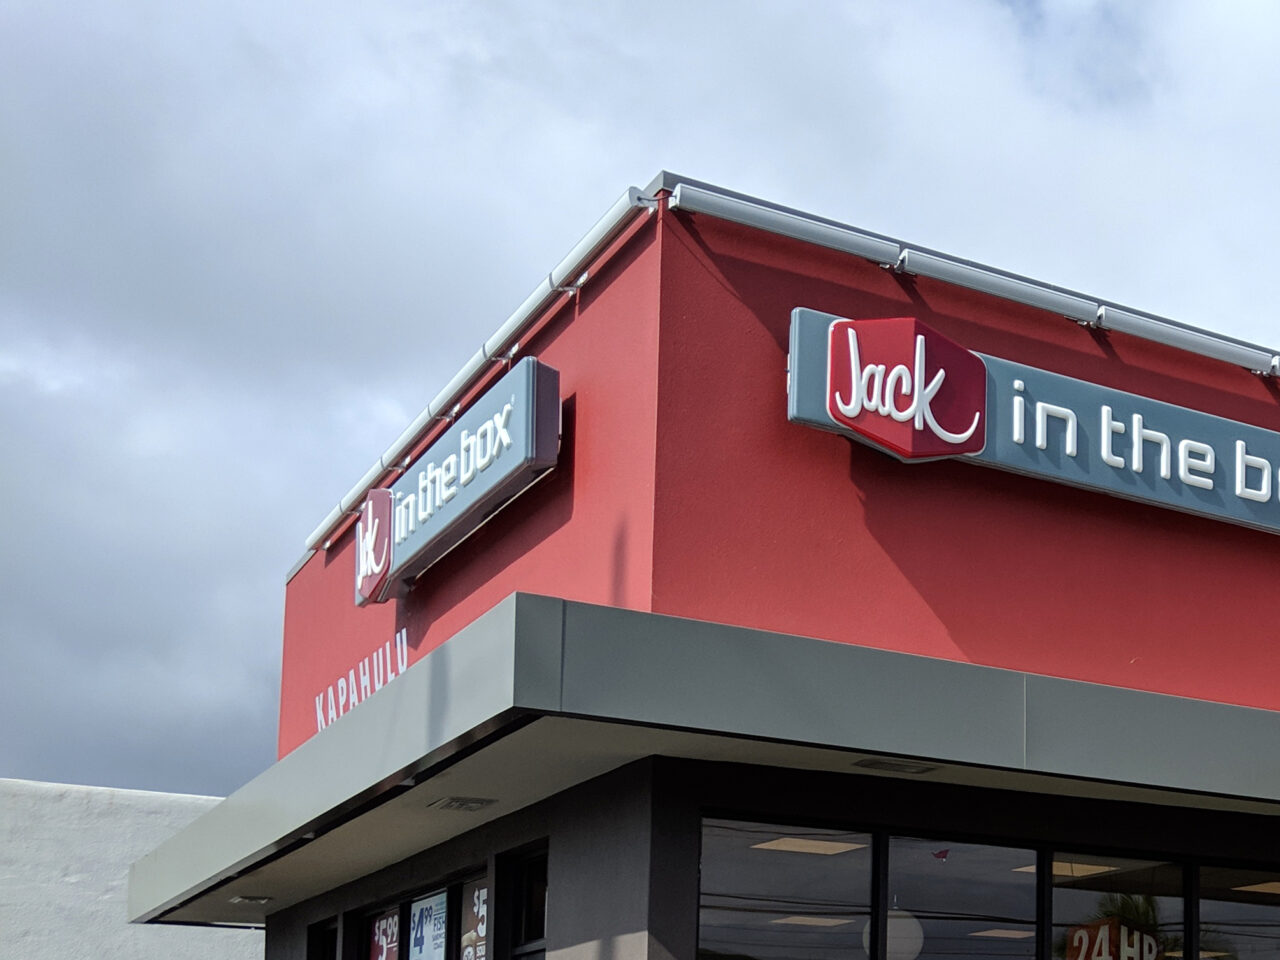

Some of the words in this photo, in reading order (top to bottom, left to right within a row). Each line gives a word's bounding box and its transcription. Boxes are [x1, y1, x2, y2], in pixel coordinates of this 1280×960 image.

[395, 491, 416, 545] in
[418, 462, 457, 525] the
[460, 403, 512, 487] box
[835, 327, 980, 444] Jack
[1012, 379, 1077, 457] in
[1101, 404, 1215, 489] the
[315, 628, 408, 733] KAPAHULU
